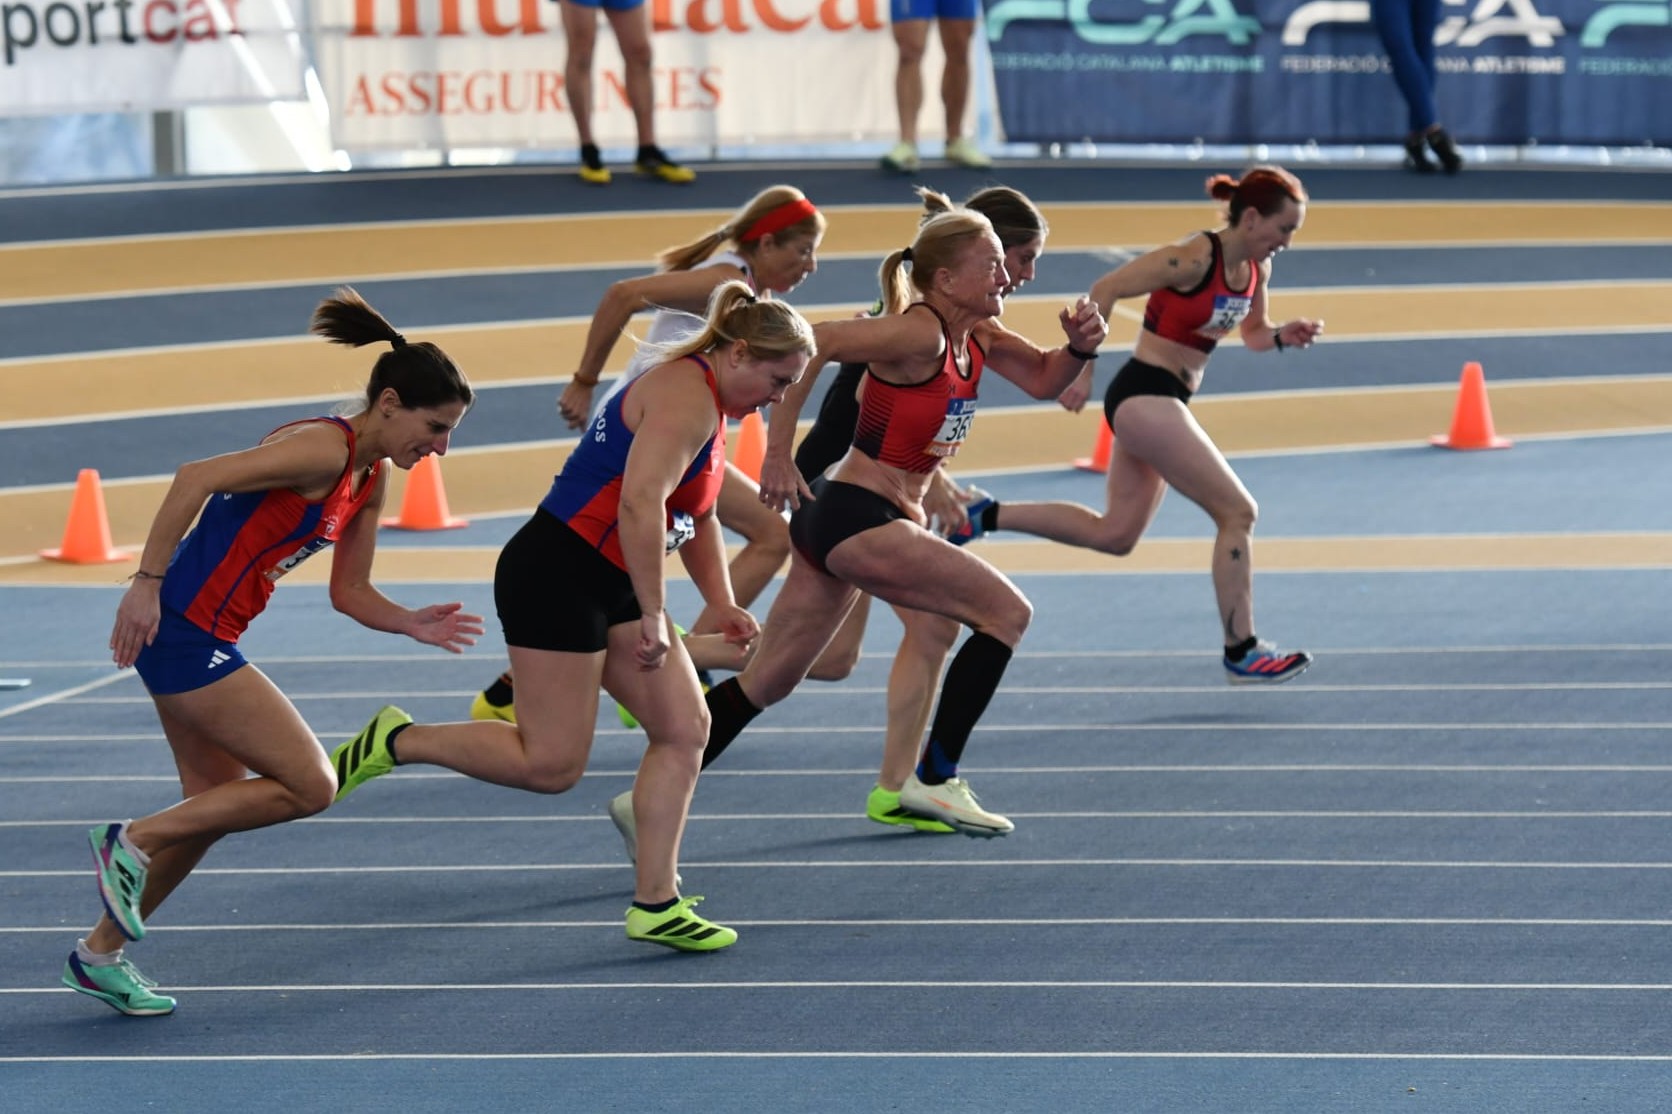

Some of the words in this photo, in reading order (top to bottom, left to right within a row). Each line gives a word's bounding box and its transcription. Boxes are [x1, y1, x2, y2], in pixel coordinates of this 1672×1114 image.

[2, 0, 242, 65] portca
[344, 66, 723, 117] ASSEGURNES
[945, 415, 975, 442] 36
